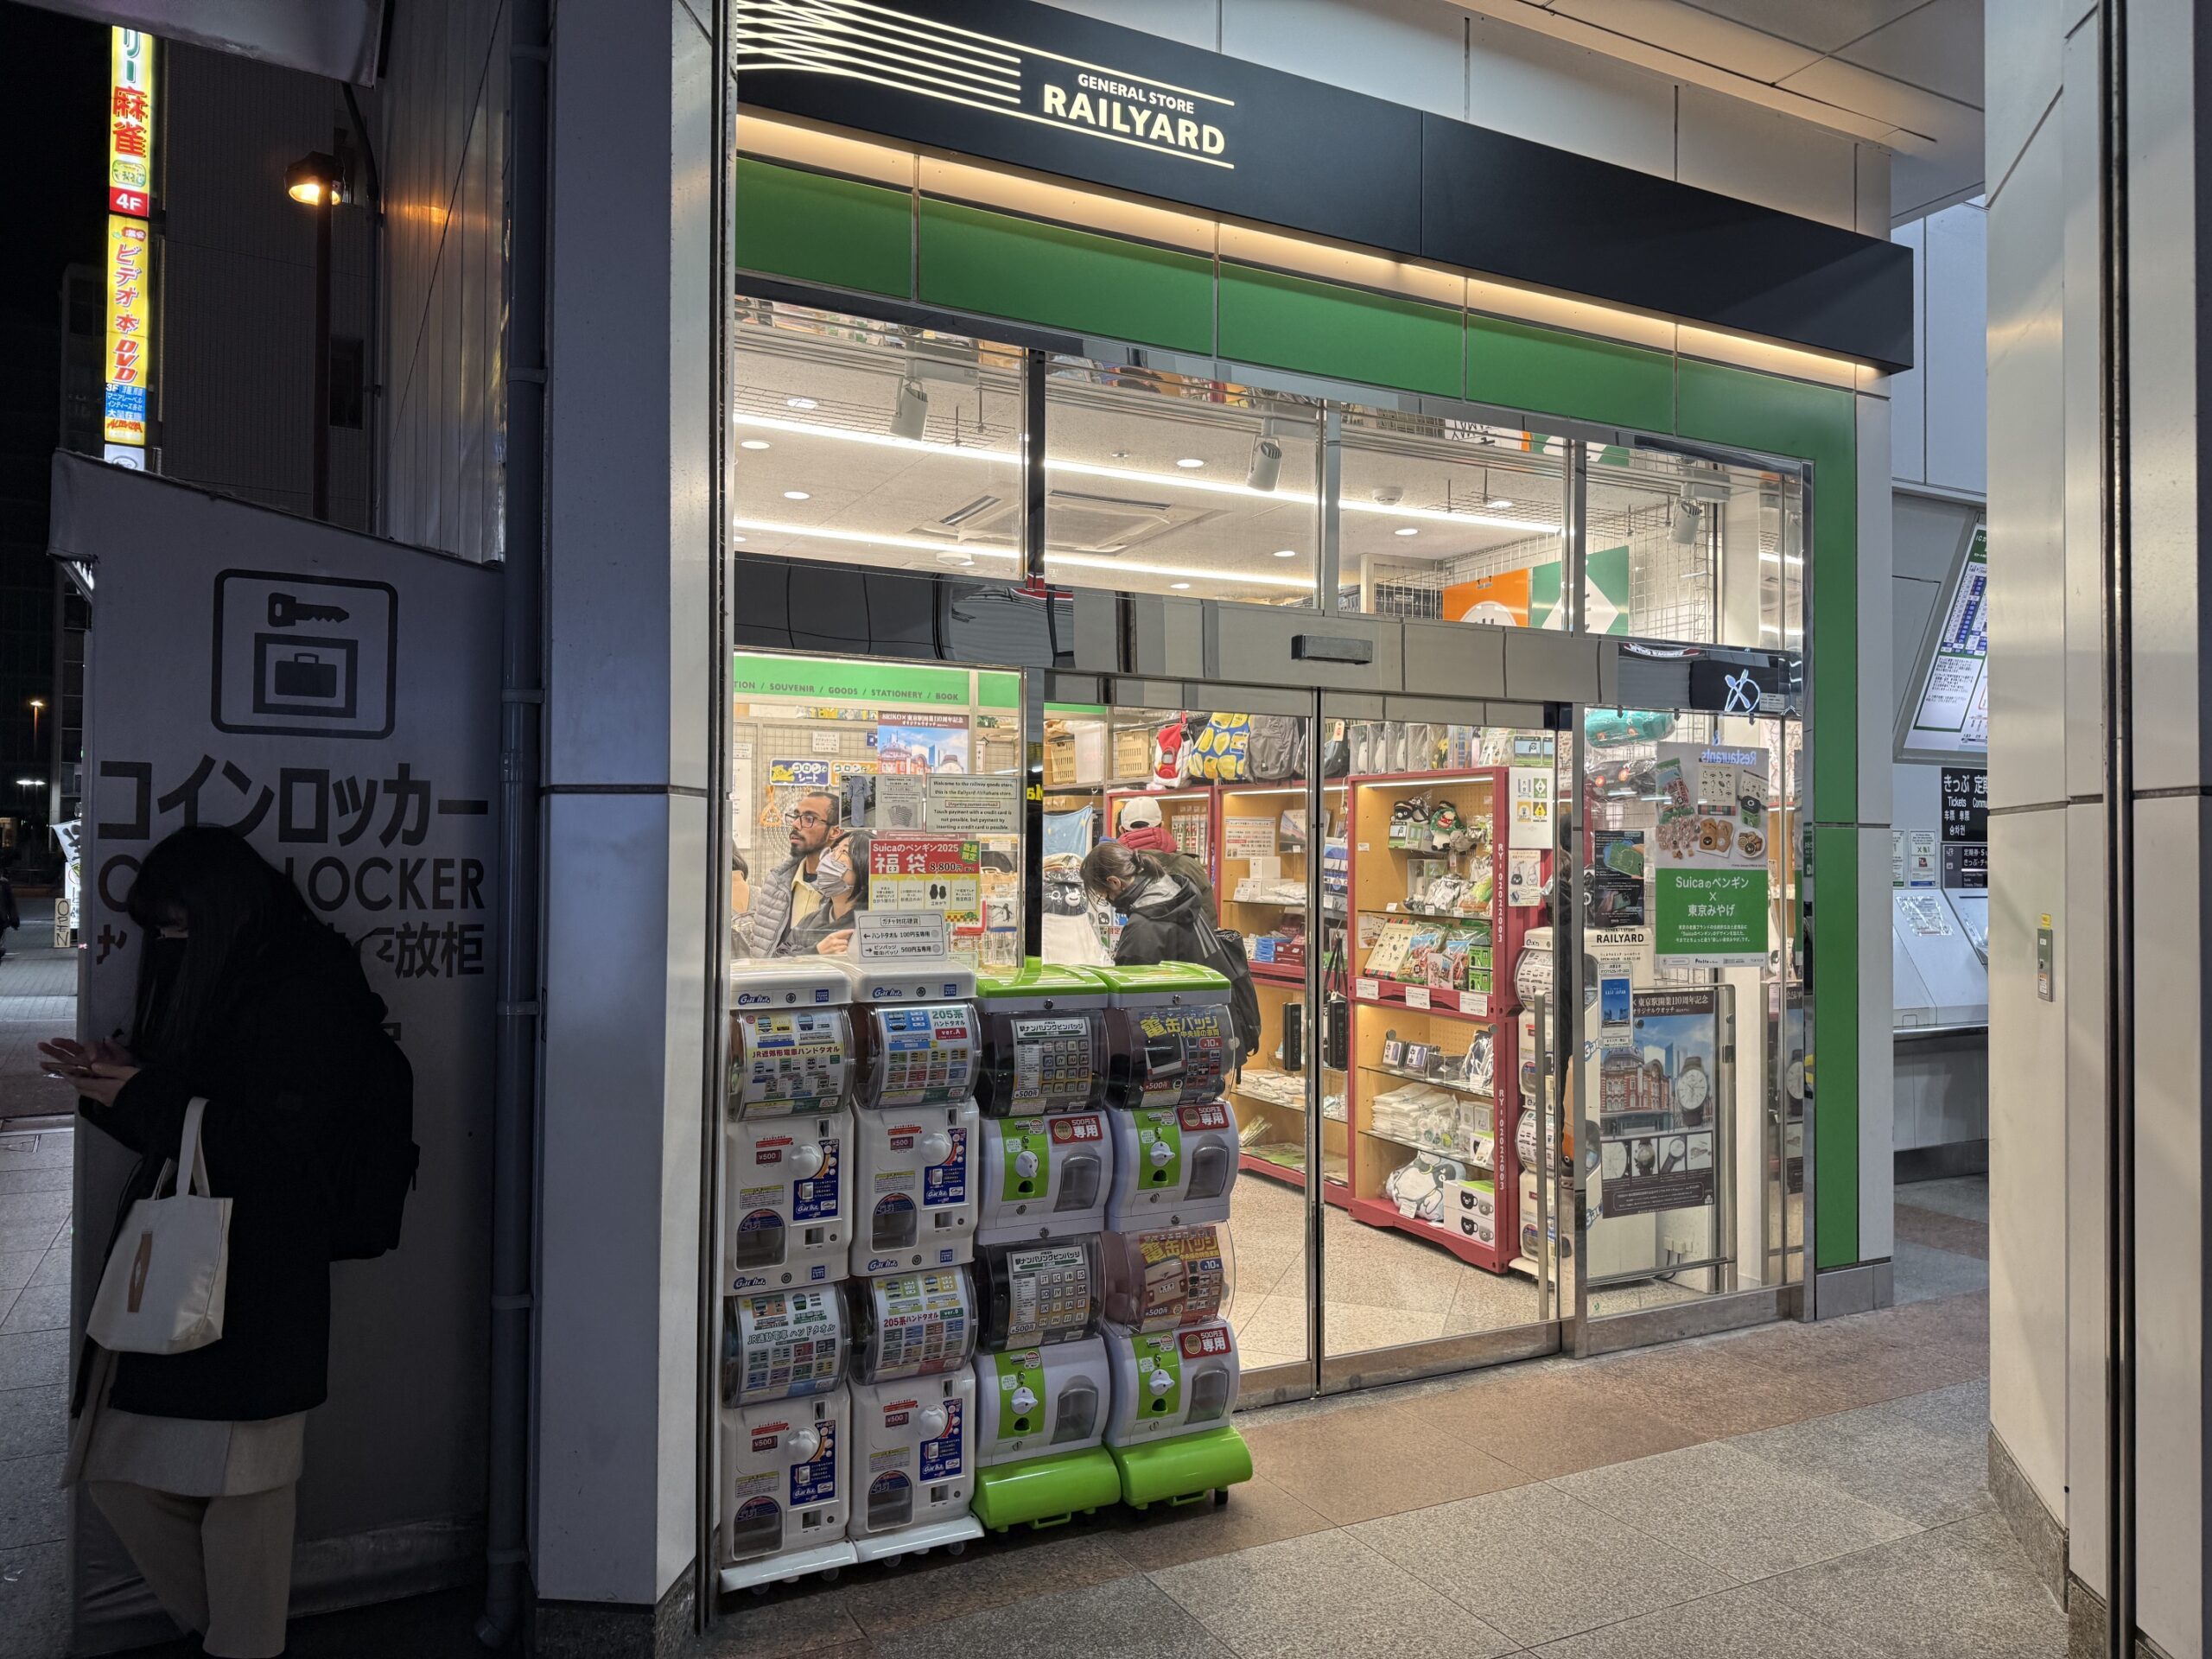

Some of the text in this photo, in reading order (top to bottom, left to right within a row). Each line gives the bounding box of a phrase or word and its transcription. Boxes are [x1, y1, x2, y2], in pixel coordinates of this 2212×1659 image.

[1077, 73, 1194, 114] GENERAL STORE
[1043, 83, 1225, 156] RAILYARD
[116, 193, 143, 211] 4F
[106, 384, 119, 392] 3F
[769, 683, 815, 693] SOUVENIR
[829, 686, 858, 695] GOODS
[871, 689, 923, 699] STATIONERY
[935, 692, 958, 701] BOOK
[1943, 774, 1969, 793] きっぷ
[97, 754, 488, 848] コインロッカー
[1948, 796, 1967, 807] Tickets
[873, 843, 959, 853] Suicaのペンギン2025
[930, 862, 963, 873] 8,800円
[1675, 875, 1749, 889] Suicaのペンギン
[1688, 904, 1735, 917] 東京みやげ
[1597, 934, 1644, 943] RAILYARD
[932, 1009, 963, 1019] 205系
[1203, 1337, 1226, 1351] 専用
